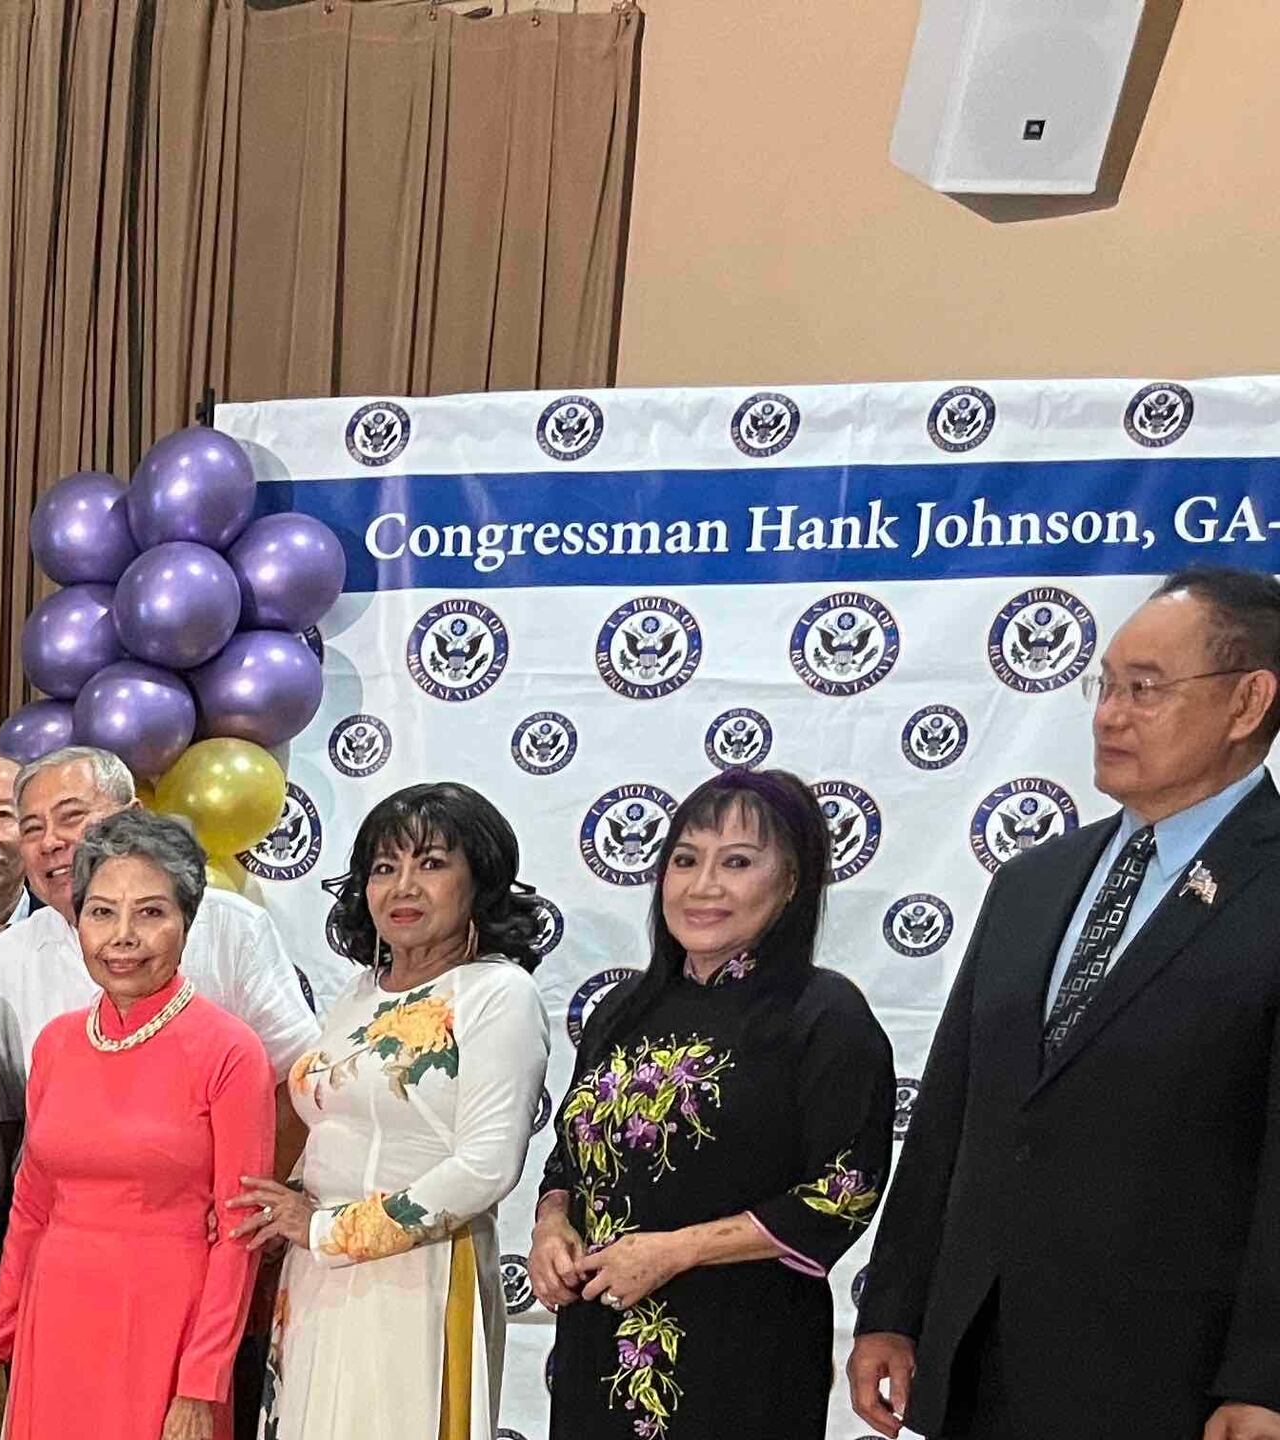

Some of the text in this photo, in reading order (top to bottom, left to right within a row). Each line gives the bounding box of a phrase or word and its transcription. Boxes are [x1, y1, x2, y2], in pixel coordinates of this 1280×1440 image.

[364, 512, 728, 572] Congressman
[746, 499, 899, 552] Hank
[911, 497, 1155, 558] Johnson,
